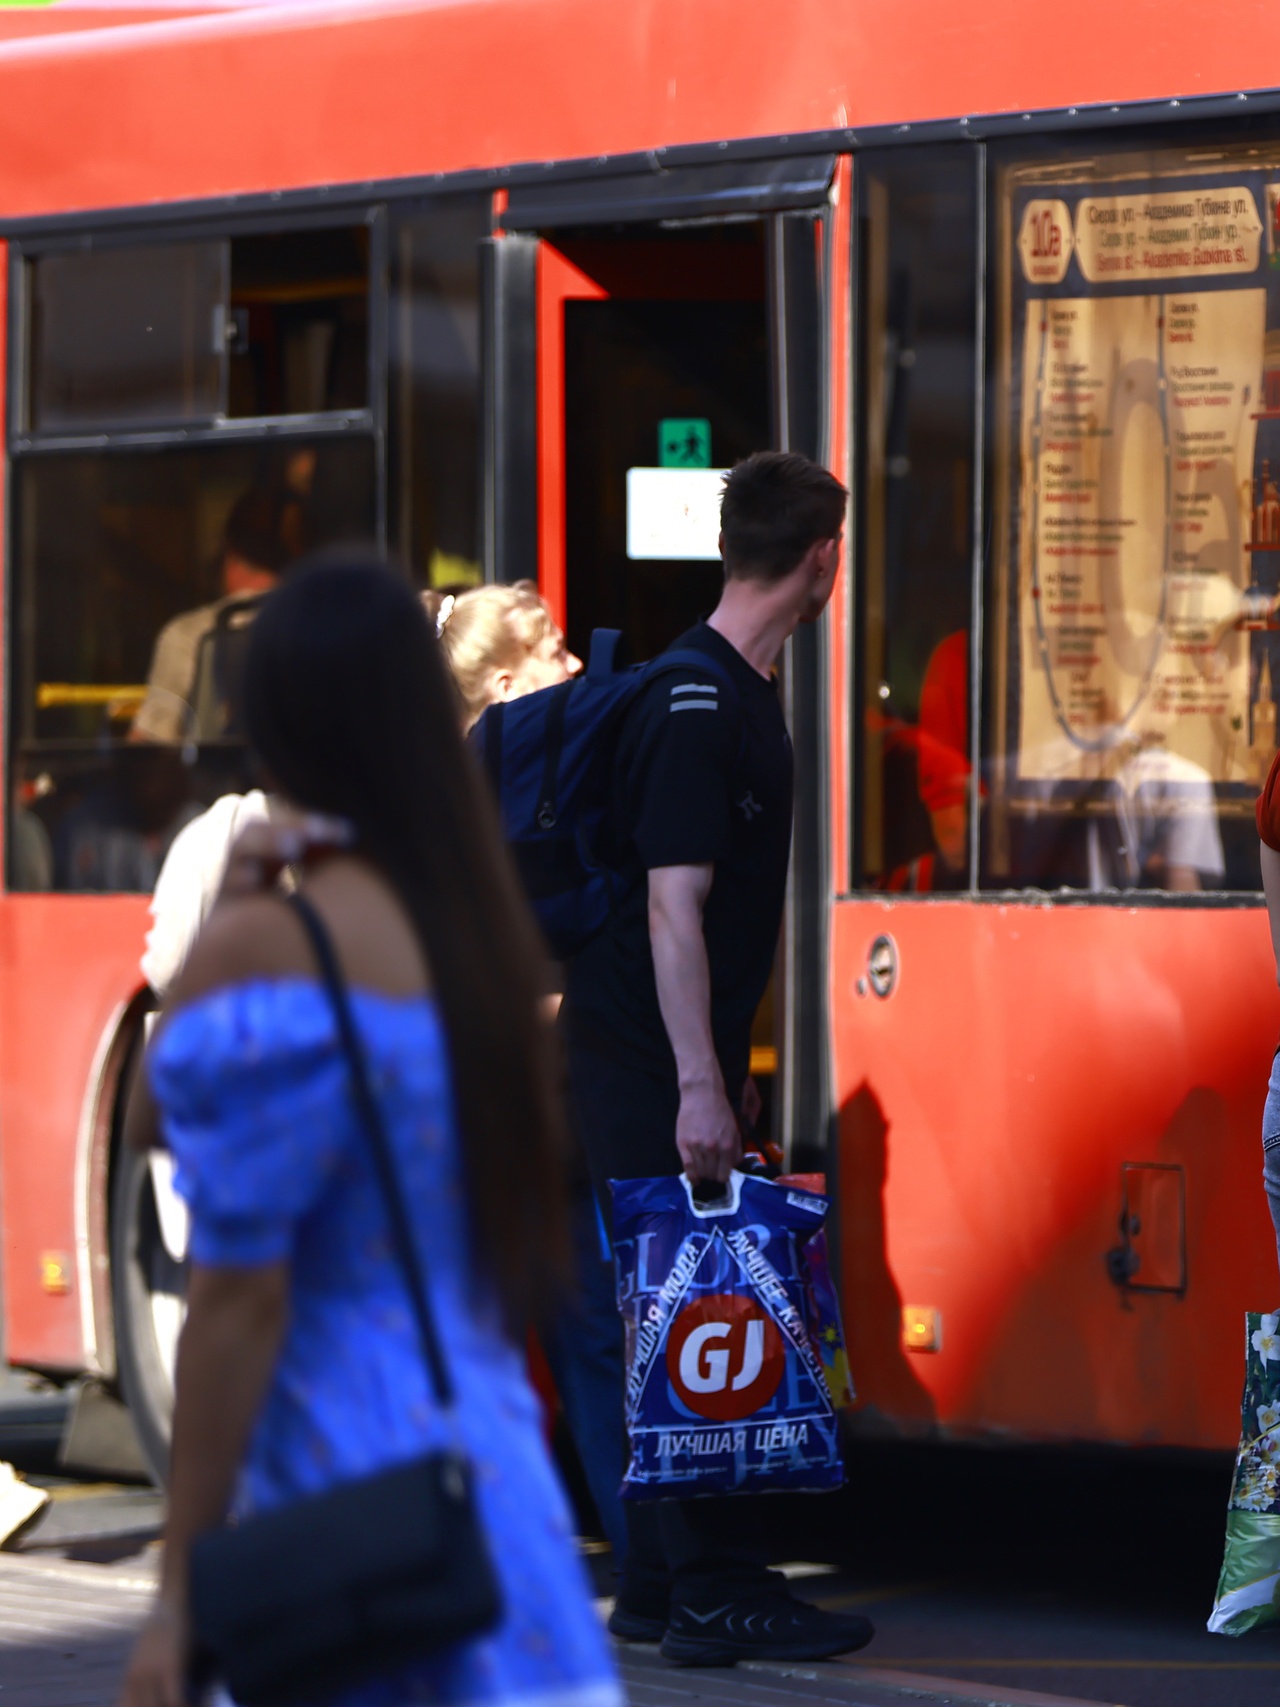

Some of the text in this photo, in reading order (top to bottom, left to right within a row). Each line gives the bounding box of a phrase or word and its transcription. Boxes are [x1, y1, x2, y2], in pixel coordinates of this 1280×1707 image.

[660, 1241, 701, 1306] МОДА
[727, 1229, 789, 1306] ЛУЧШЕЕ
[678, 1318, 765, 1395] GJ
[654, 1423, 810, 1459] ЛУЧШАЯ ЦЕНА
